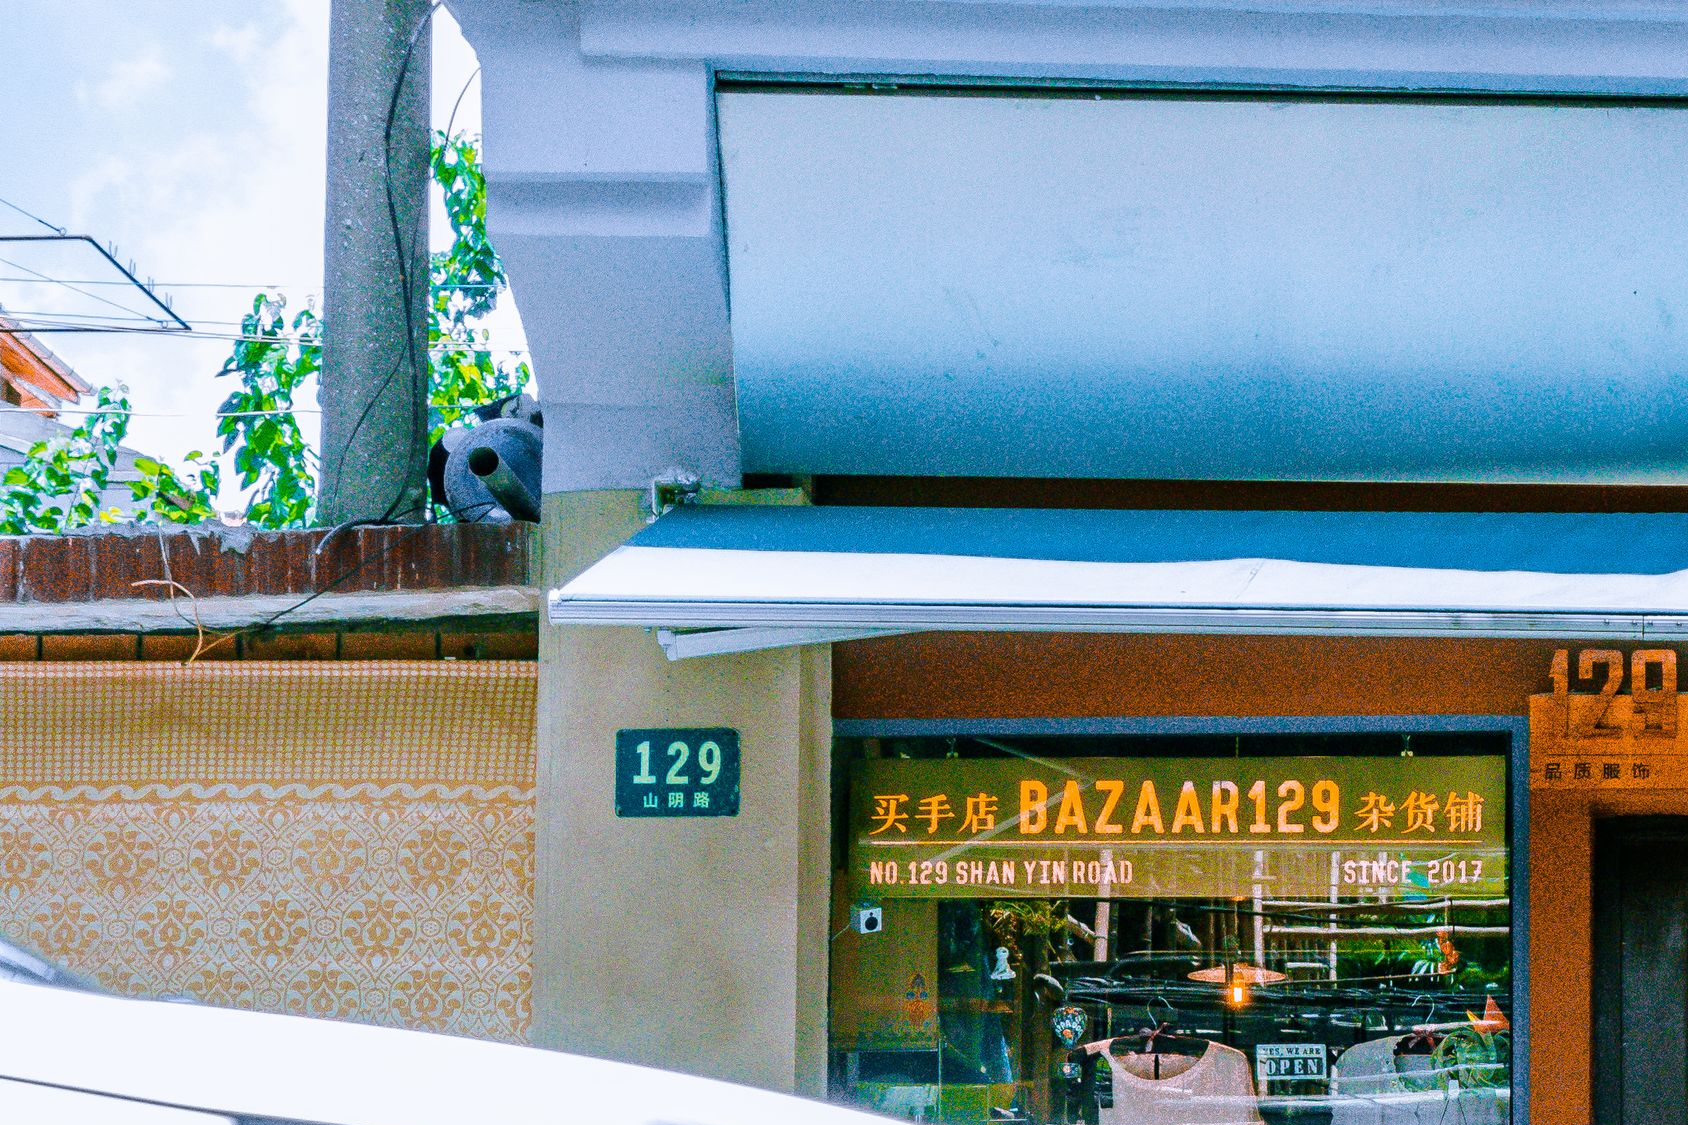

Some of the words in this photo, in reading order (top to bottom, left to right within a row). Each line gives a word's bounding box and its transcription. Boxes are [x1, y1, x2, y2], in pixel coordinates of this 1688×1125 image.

[1549, 649, 1678, 739] 129
[632, 740, 722, 785] 129
[642, 791, 710, 809] 山阴路
[869, 794, 999, 836] 买手店
[1017, 779, 1341, 835] BAZAAR129
[1352, 790, 1486, 835] 杂货铺
[868, 858, 949, 886] NO.129
[954, 860, 1016, 886] SHAN
[1024, 860, 1066, 885] YIN
[1072, 860, 1134, 886] ROAD
[1342, 858, 1412, 885] SINCE
[1427, 858, 1485, 884] 2017
[1265, 1058, 1320, 1076] OPEN
